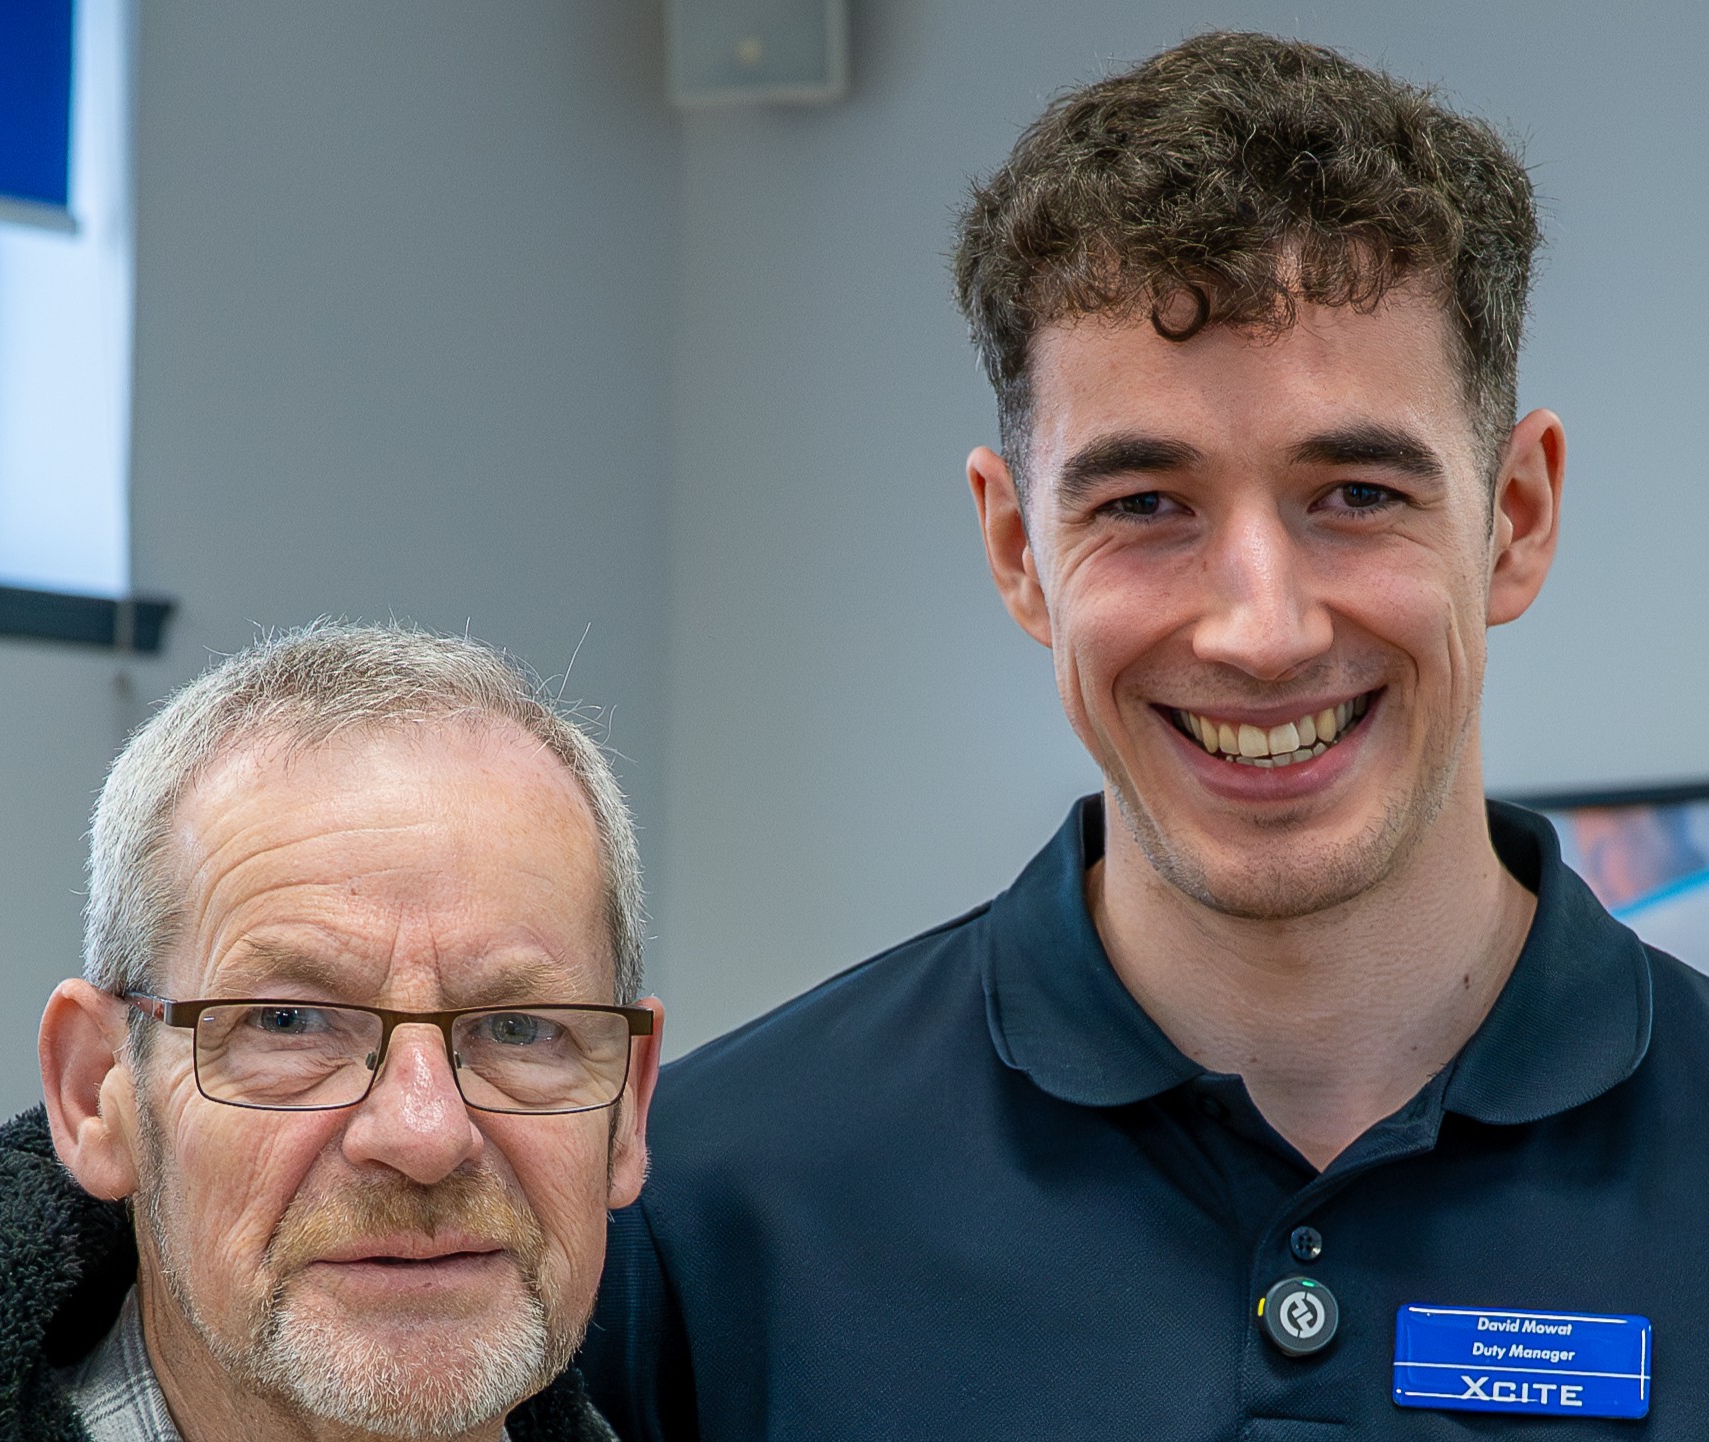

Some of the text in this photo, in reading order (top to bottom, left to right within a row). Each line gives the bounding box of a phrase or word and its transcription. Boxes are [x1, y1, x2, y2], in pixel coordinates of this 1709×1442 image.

[1477, 1317, 1572, 1335] David Mowat
[1472, 1342, 1575, 1362] Duty Manager
[1461, 1375, 1583, 1406] XCITE
